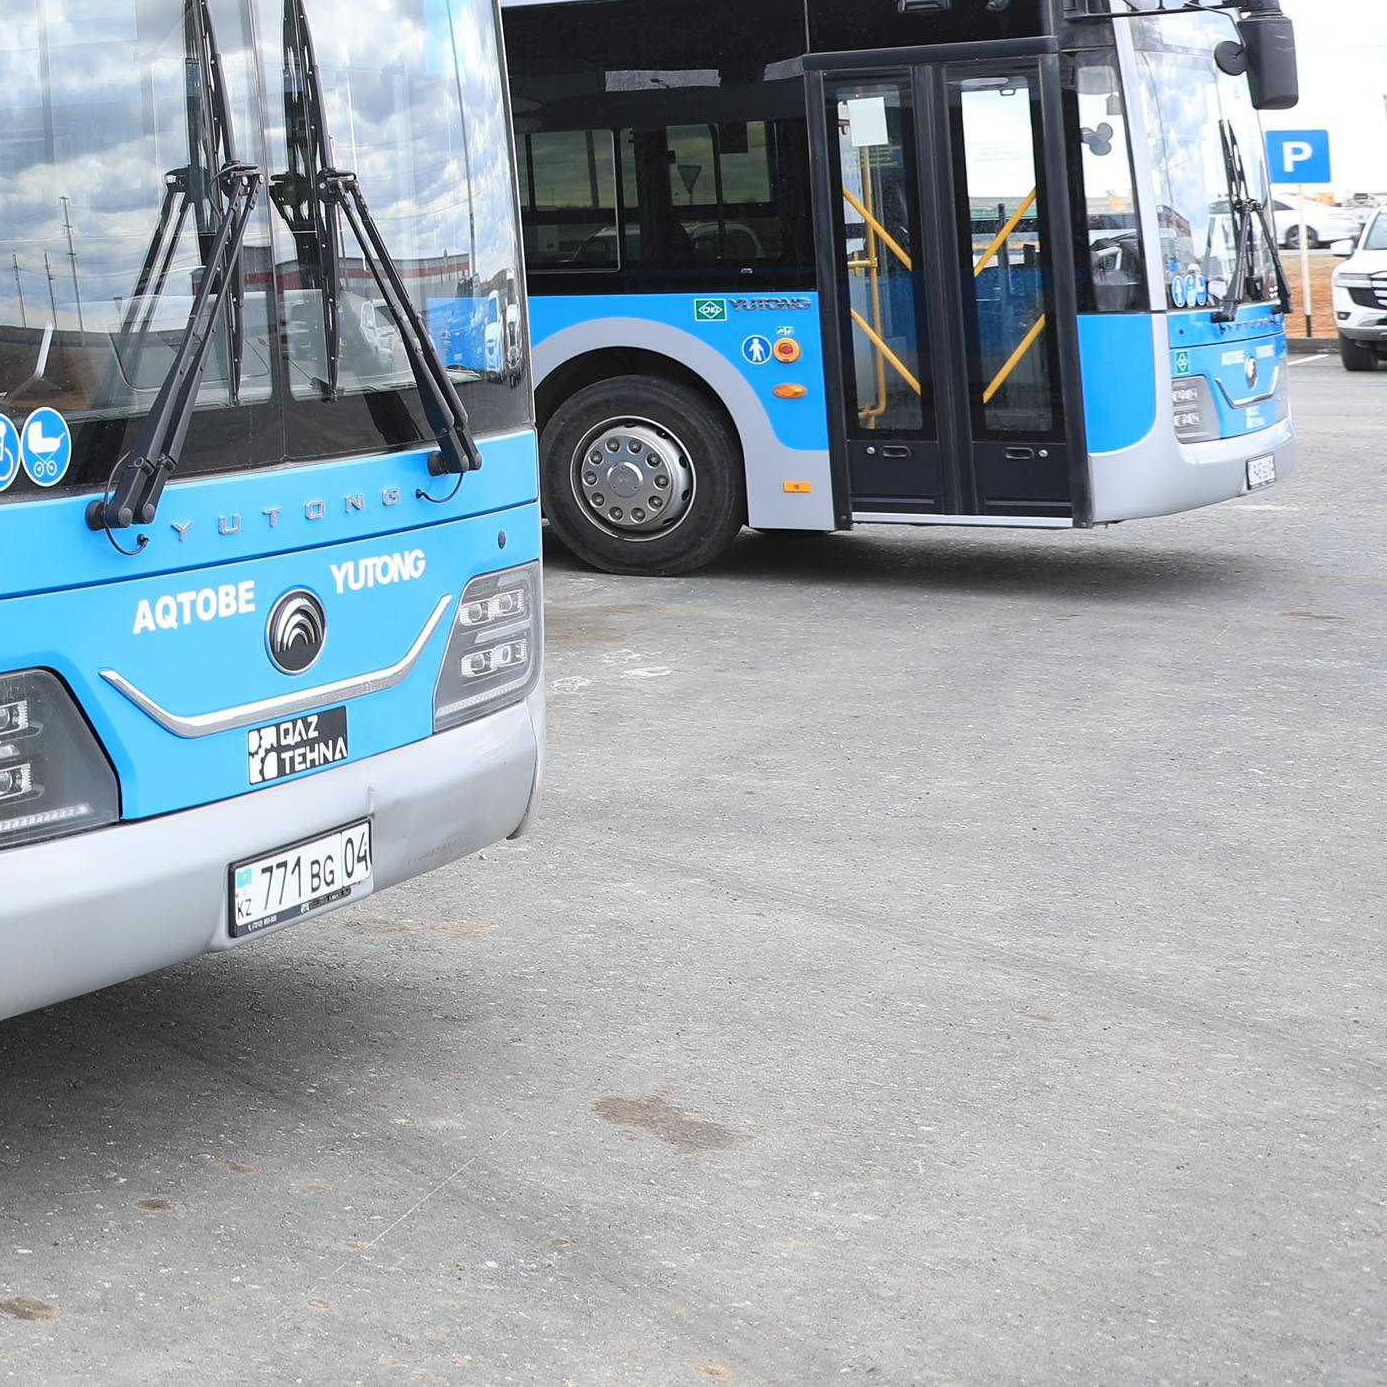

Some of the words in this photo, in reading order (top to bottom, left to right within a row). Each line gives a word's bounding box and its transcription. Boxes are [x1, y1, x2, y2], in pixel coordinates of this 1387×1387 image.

[1283, 141, 1313, 173] P
[729, 297, 812, 311] YUTONG
[171, 486, 401, 541] YUTONG
[330, 549, 426, 594] YUTONG
[133, 580, 256, 634] AQTOBE
[280, 714, 319, 746] QAZ
[281, 736, 348, 775] TEHNA
[260, 855, 302, 911] 771
[310, 854, 335, 894] BG
[343, 830, 369, 880] 04
[237, 898, 252, 920] KZ
